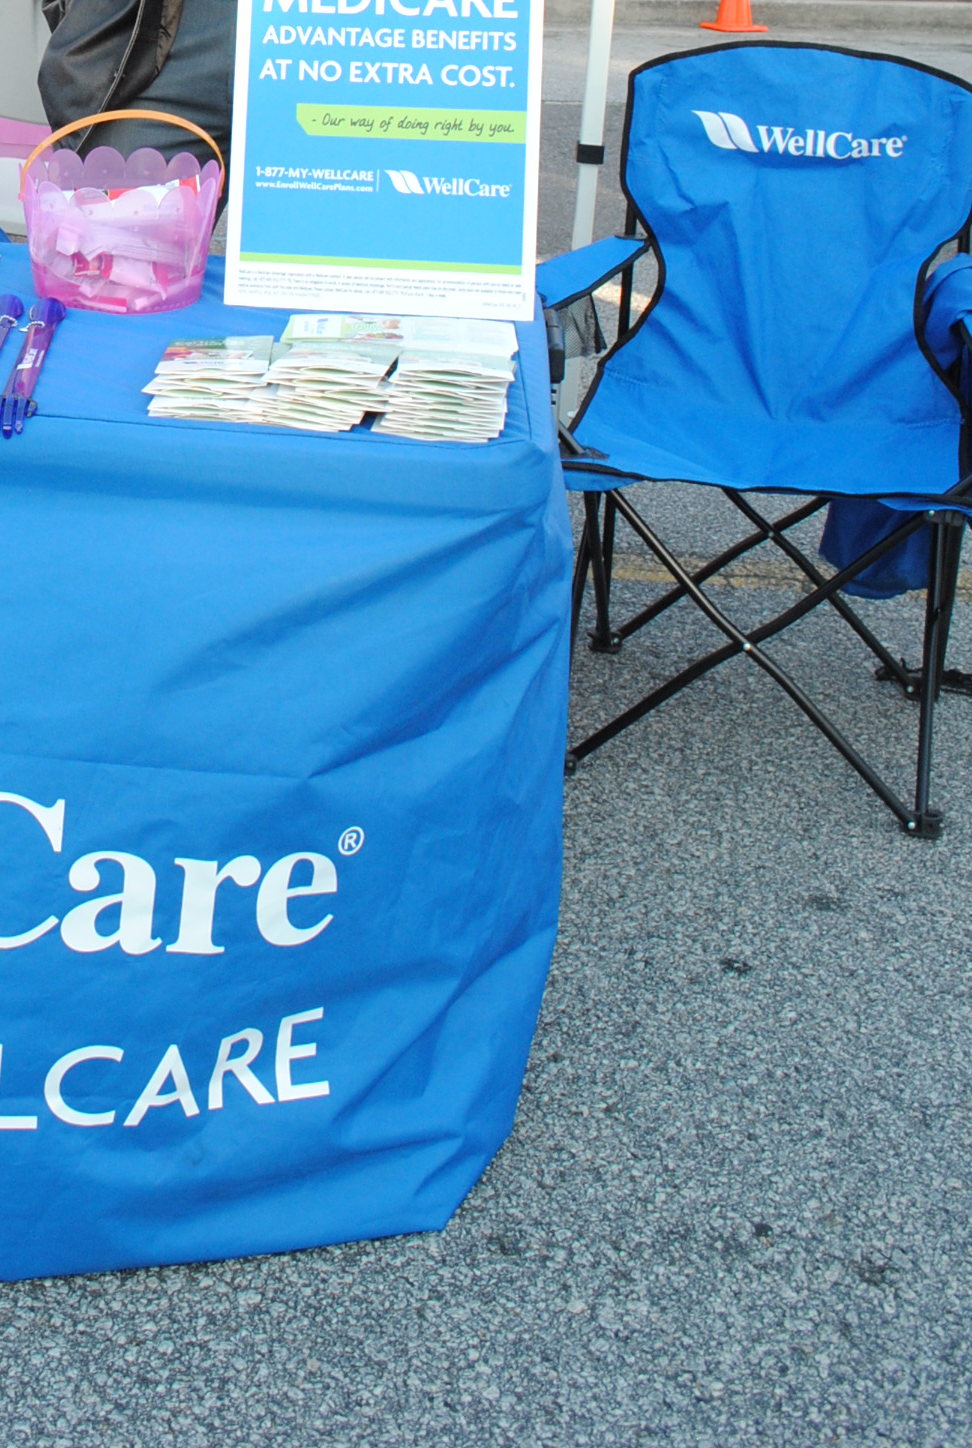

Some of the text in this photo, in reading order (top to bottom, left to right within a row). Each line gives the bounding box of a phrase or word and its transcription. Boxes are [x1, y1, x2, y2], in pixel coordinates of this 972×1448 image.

[262, 24, 517, 52] ADVANTAGE BENEFITS
[258, 58, 516, 89] AT NO EXTRA COST.
[322, 112, 346, 127] Our
[349, 117, 375, 133] way
[379, 116, 395, 133] of
[397, 115, 429, 136] doing
[434, 117, 463, 136] right
[468, 118, 484, 137] by
[489, 123, 515, 138] you.
[255, 165, 374, 182] 1-877-MY-WELLCARE
[255, 180, 374, 193] www.EnrollWellCarePlans.com
